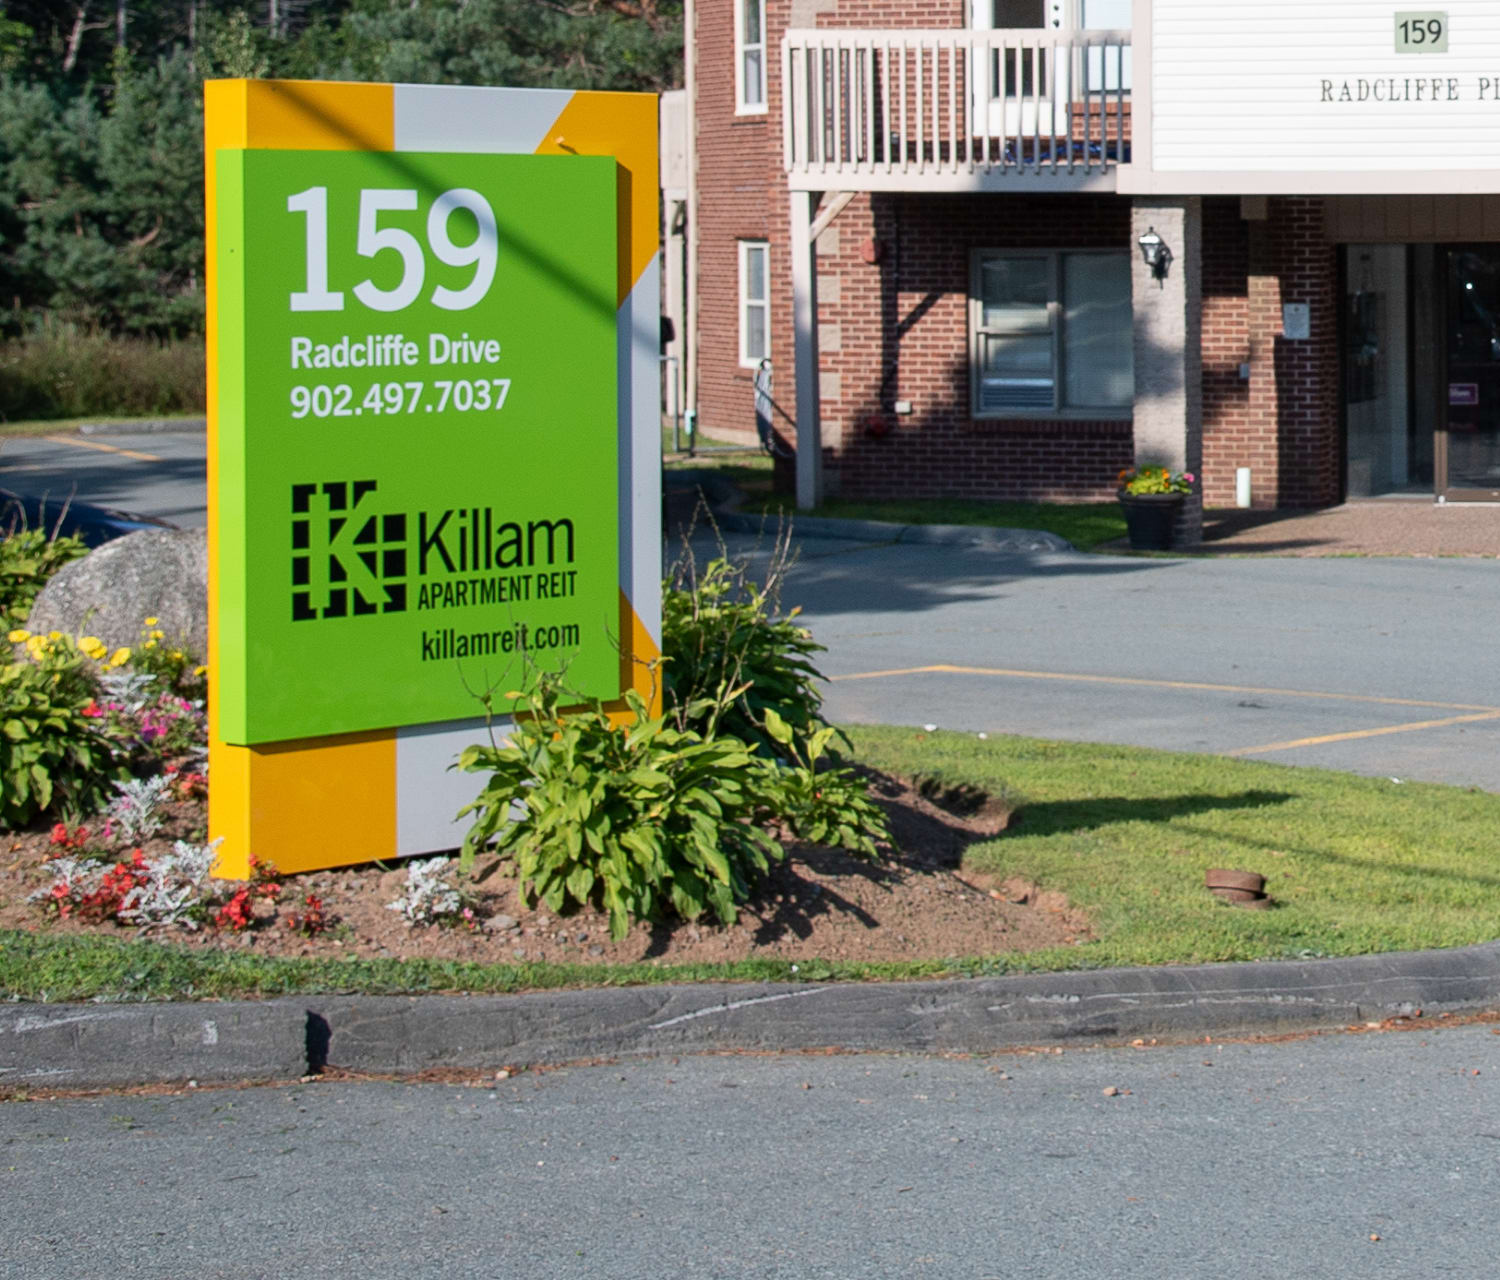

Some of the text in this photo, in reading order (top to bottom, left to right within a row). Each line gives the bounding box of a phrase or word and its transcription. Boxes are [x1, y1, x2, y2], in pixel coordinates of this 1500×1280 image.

[1399, 19, 1442, 44] 159
[1320, 78, 1460, 102] RADCLIFFE
[287, 186, 499, 312] 159
[290, 332, 501, 369] Radcliffe Drive
[290, 378, 512, 419] 902.497.7037
[419, 507, 575, 576] Killam
[418, 570, 577, 611] APARTMENT REIT
[421, 622, 580, 661] killamreit.com
